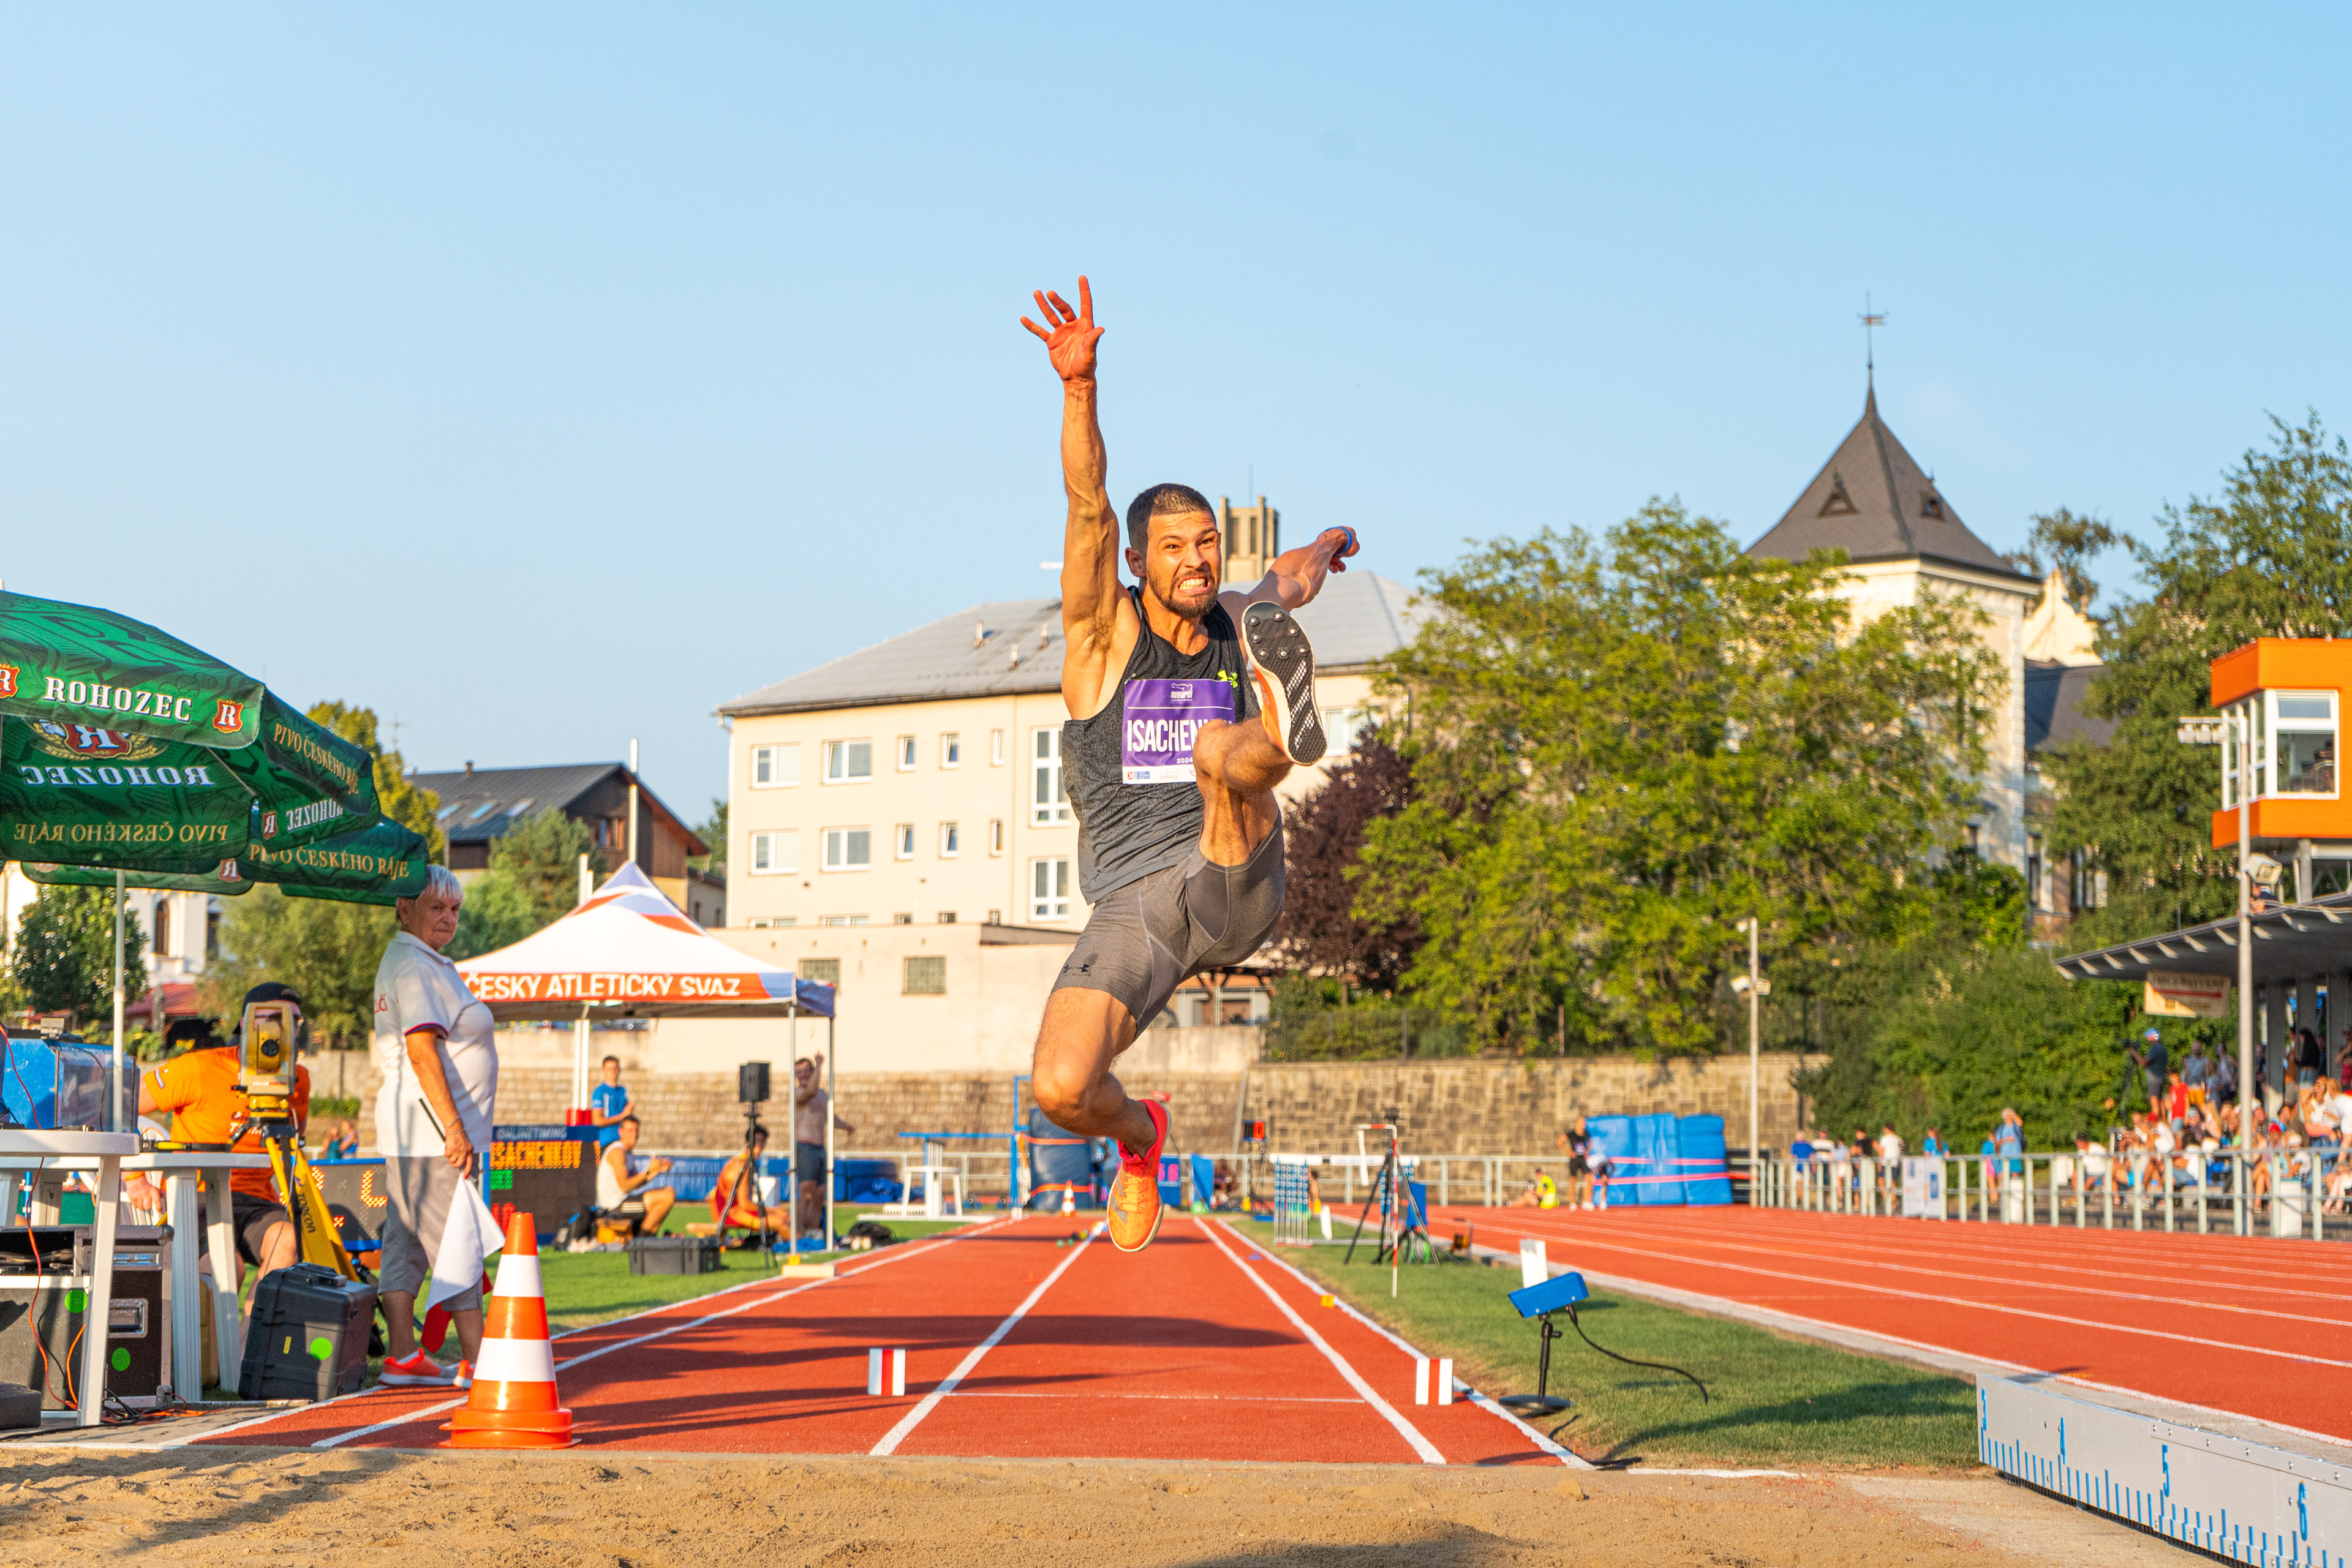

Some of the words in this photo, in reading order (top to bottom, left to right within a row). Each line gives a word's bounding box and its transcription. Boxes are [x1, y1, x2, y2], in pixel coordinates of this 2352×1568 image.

[43, 676, 192, 722] ROHOZEC
[218, 704, 237, 727] R
[274, 723, 302, 753] PIVO
[303, 735, 345, 781] ČESKÉHO
[1128, 719, 1232, 752] ISACHEN
[296, 846, 373, 873] ČESKÉHO
[378, 856, 409, 880] RÁJE
[465, 972, 542, 1000] ČESKÝ
[546, 973, 673, 998] ATLETICKÝ
[680, 976, 741, 997] SVAZ
[2162, 1444, 2170, 1498] 5
[2298, 1481, 2308, 1542] 6
